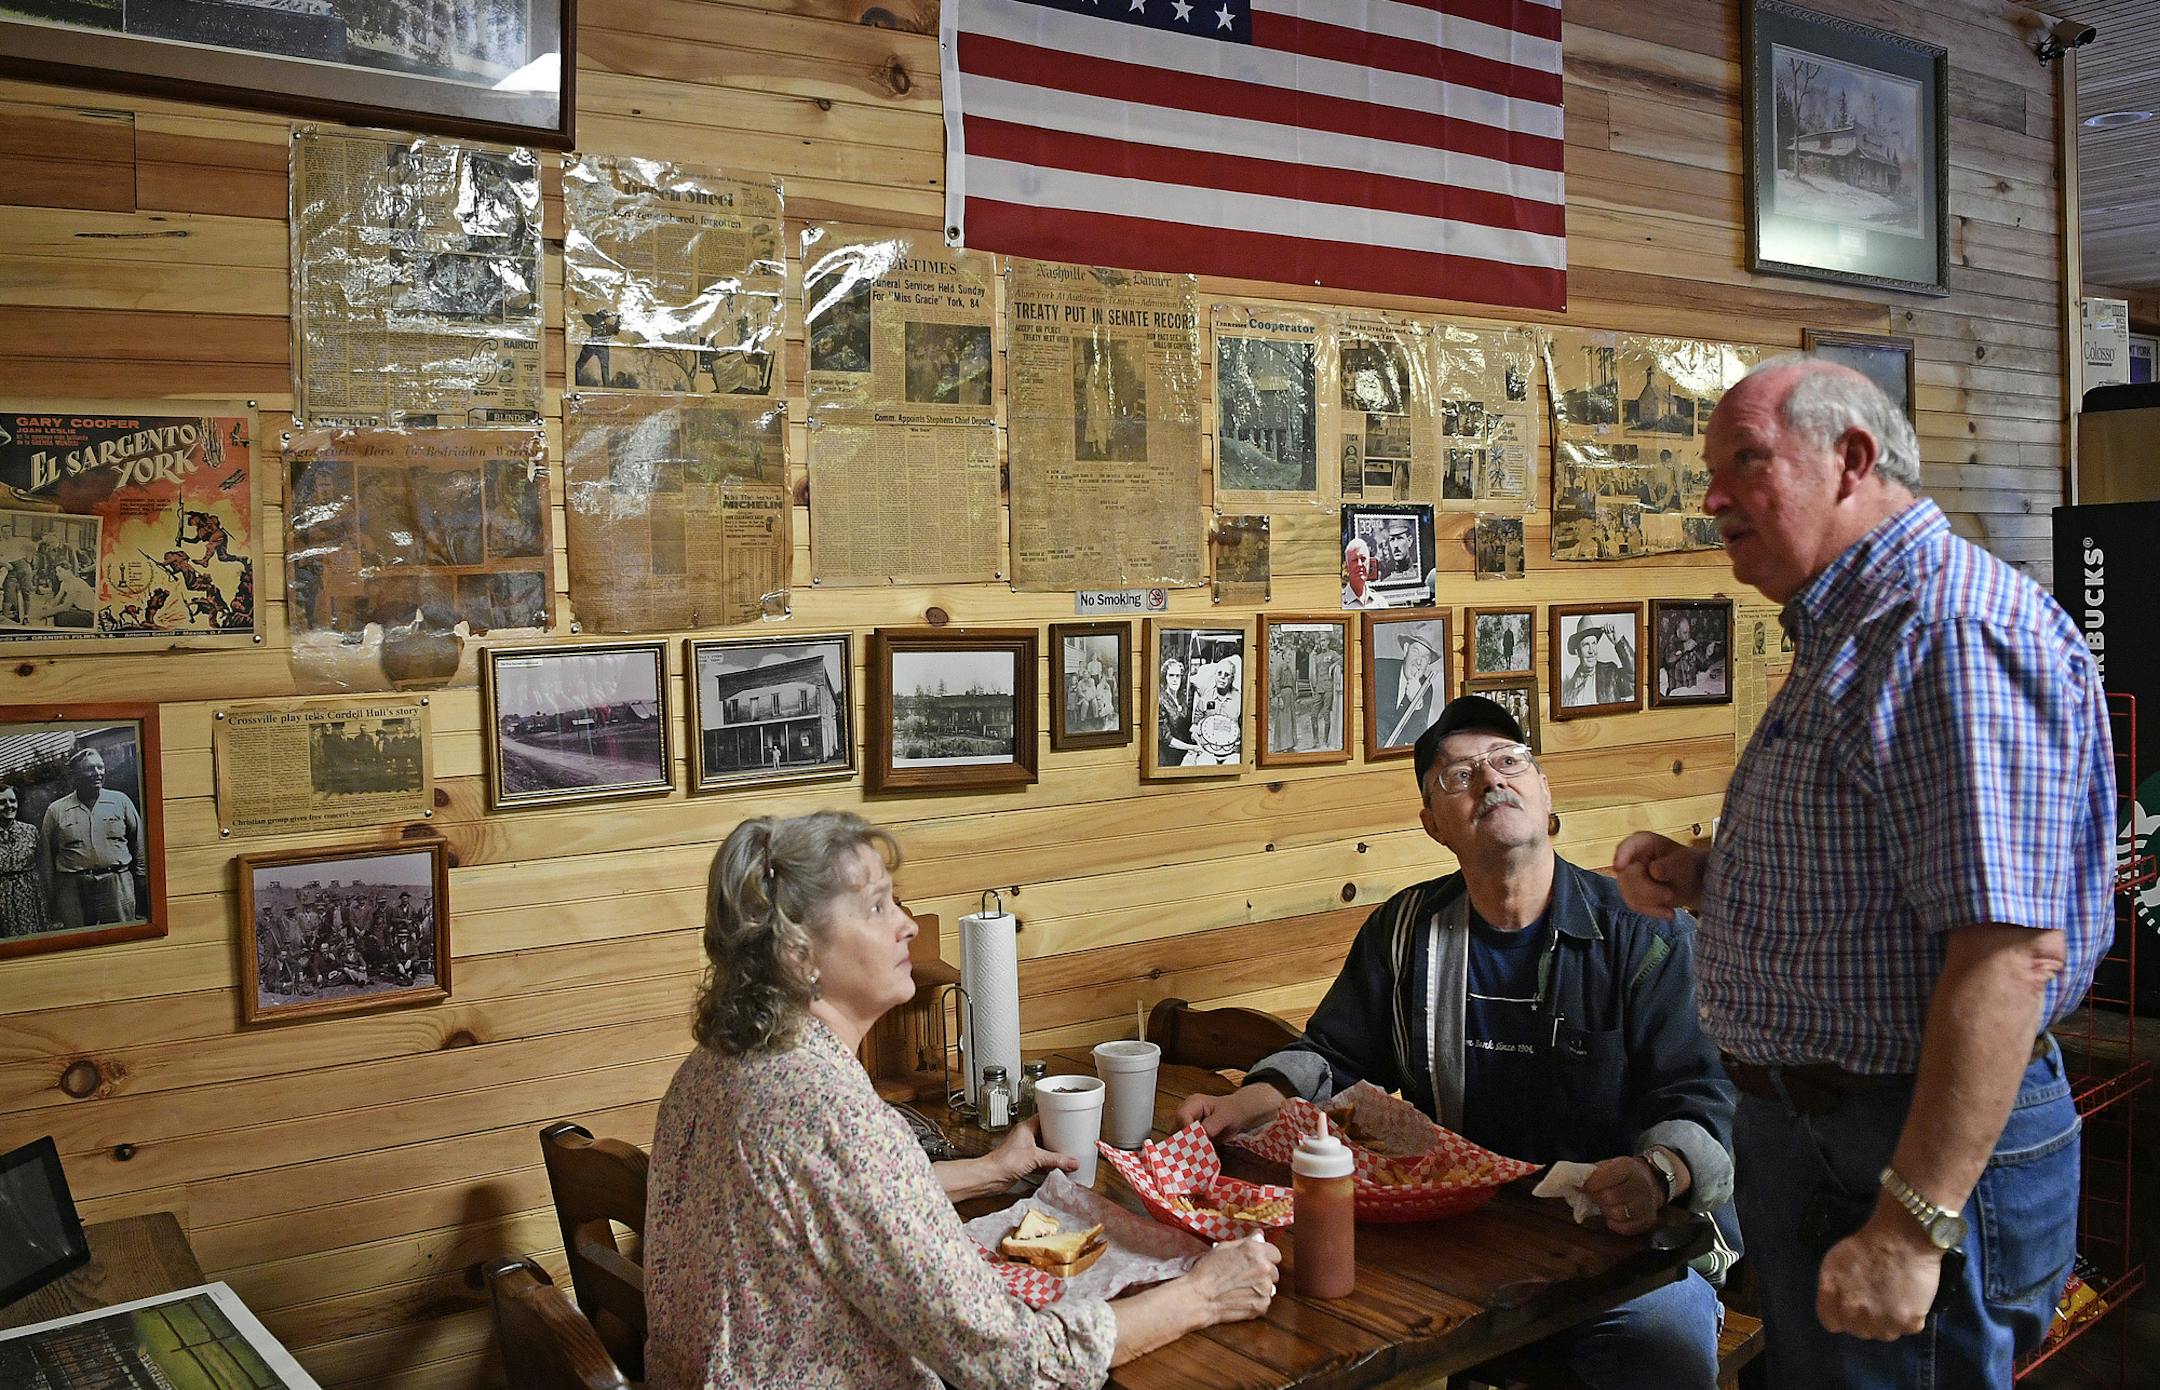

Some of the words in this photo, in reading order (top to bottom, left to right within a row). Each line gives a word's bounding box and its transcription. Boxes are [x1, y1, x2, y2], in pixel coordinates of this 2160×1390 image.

[701, 215, 742, 228] forgotten
[1036, 263, 1086, 282] Nashville
[904, 281, 935, 292] Services
[938, 282, 955, 293] Held
[958, 285, 986, 298] Sunday
[872, 290, 885, 301] For
[970, 299, 980, 308] 84
[1014, 302, 1059, 321] TREATY
[1065, 305, 1086, 323] PUT
[1092, 307, 1103, 325] IN
[1108, 309, 1149, 327] SENATE
[1154, 312, 1195, 329] RECORD
[1249, 319, 1316, 336] Cooperator
[503, 340, 539, 350] HAIRCUT
[2084, 341, 2116, 361] Colosso
[16, 417, 63, 427] GARY
[70, 418, 140, 429] COOPER
[874, 413, 897, 423] Comm.
[65, 422, 198, 478] SARGENTO
[111, 442, 200, 492] YORK
[722, 500, 783, 509] MICHELIN
[1081, 593, 1095, 606] No
[1097, 593, 1142, 607] Smoking
[228, 714, 278, 726] Crossville
[281, 713, 302, 724] play
[304, 711, 325, 721] tells
[327, 710, 363, 720] Cordell
[366, 707, 394, 717] Hull's
[396, 706, 419, 716] story
[232, 817, 266, 827] Christian
[267, 816, 290, 826] group
[290, 814, 308, 824] gives
